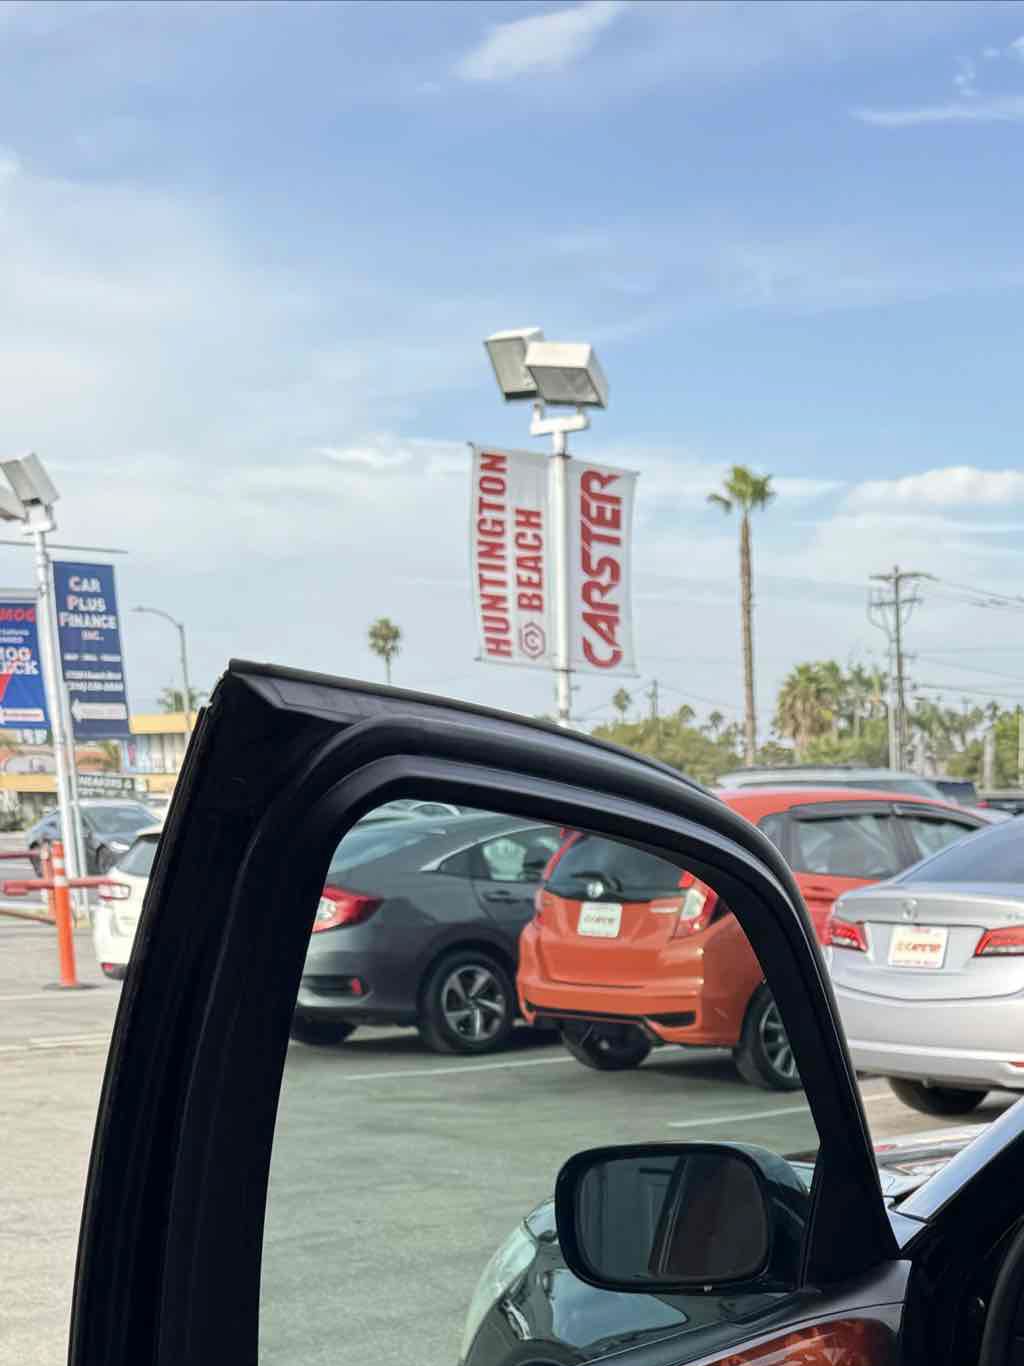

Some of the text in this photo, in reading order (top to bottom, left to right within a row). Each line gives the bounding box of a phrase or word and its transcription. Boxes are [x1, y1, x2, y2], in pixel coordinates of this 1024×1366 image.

[69, 576, 101, 593] CAR
[477, 452, 512, 657] HUNTINGTON
[514, 508, 544, 613] BEACH
[580, 469, 624, 669] CARSTER
[59, 611, 117, 630] FINANCE
[66, 595, 107, 612] PLUS
